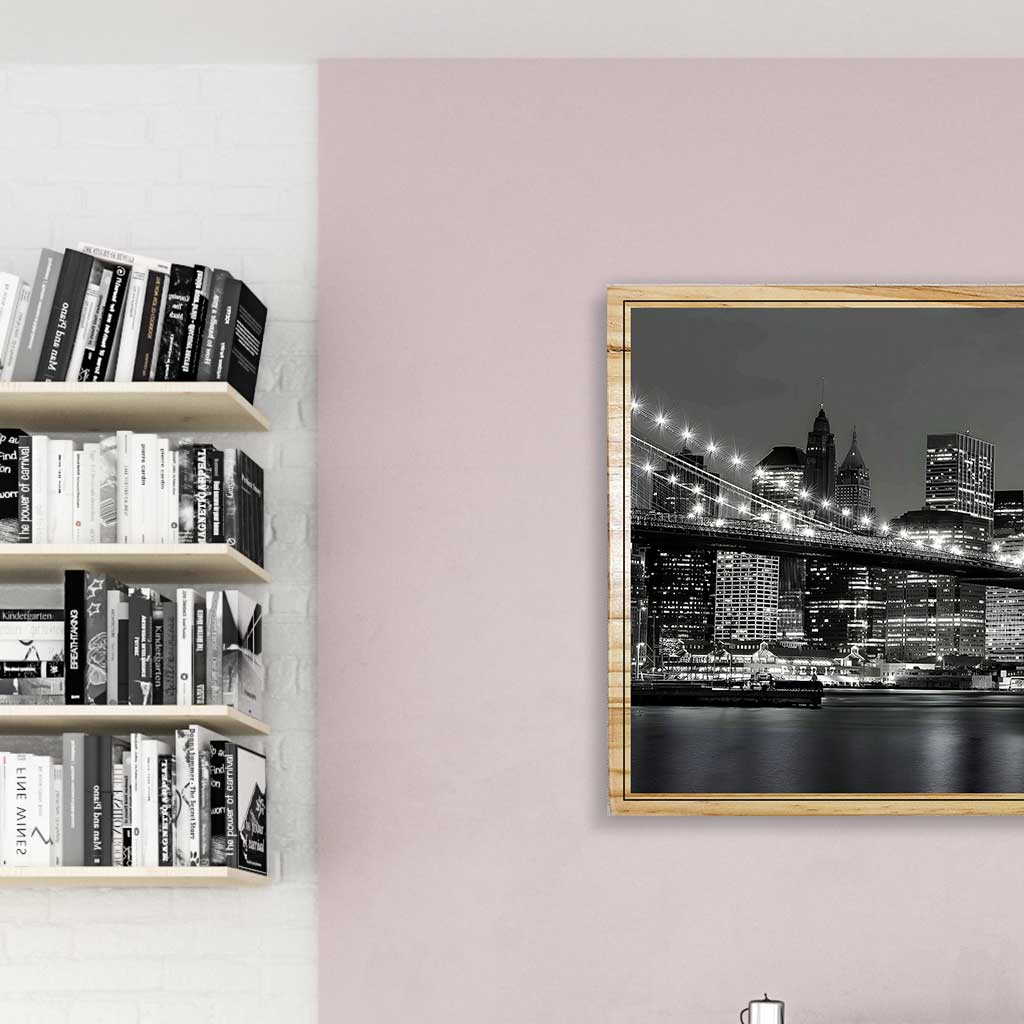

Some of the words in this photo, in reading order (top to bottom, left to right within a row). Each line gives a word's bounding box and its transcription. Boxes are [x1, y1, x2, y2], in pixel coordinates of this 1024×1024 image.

[18, 446, 30, 480] carnival
[17, 482, 30, 493] of
[20, 495, 32, 522] power
[18, 525, 30, 540] The
[2, 610, 53, 621] Kindergarten
[70, 609, 78, 669] BREATHTAKING
[153, 625, 162, 687] Kindergarten
[225, 754, 233, 791] carnival
[188, 786, 196, 798] The
[225, 794, 234, 804] of
[188, 800, 196, 820] Secret
[226, 806, 237, 837] power
[226, 836, 234, 856] The
